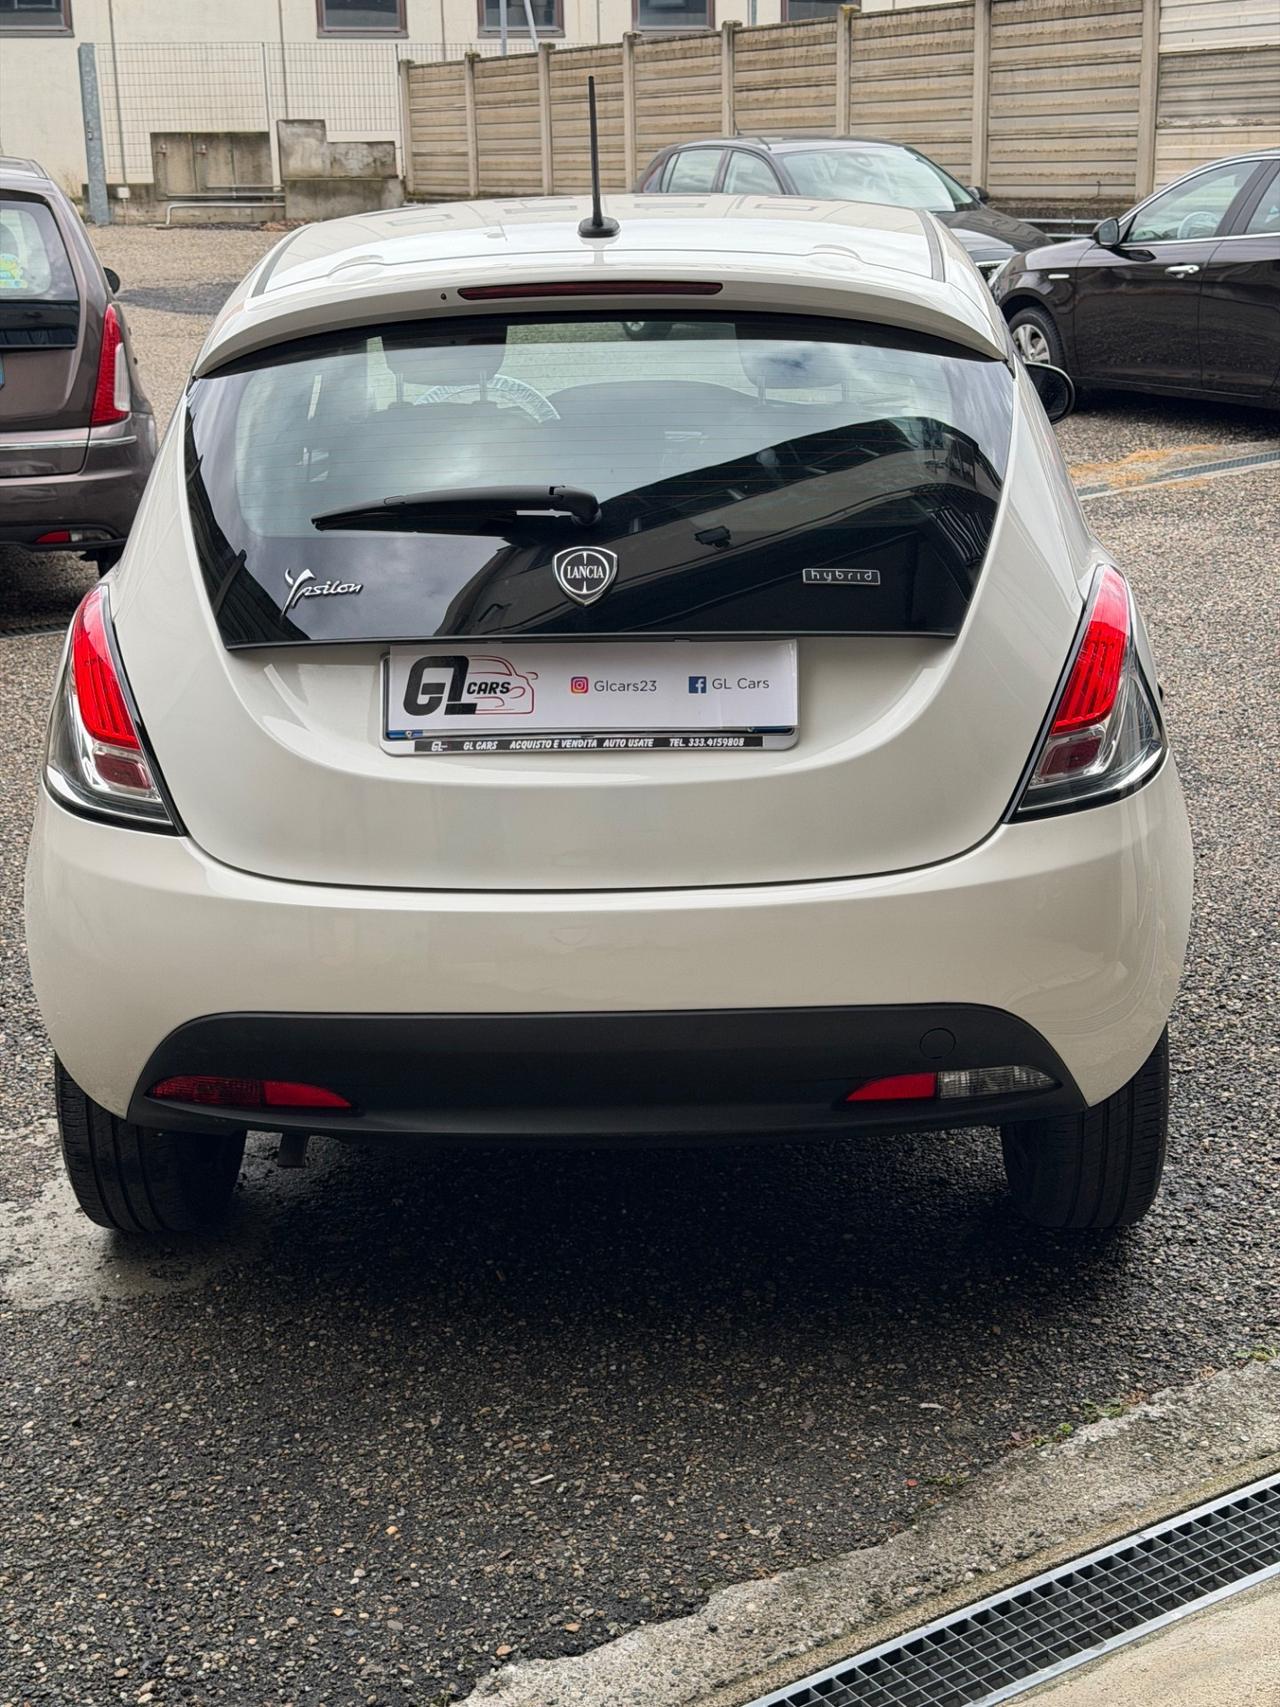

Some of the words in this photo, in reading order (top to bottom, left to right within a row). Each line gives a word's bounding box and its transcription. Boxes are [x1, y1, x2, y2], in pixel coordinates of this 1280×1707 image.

[567, 565, 604, 579] LANCIA
[811, 569, 872, 583] hybrid
[281, 568, 362, 616] Ypsilon
[467, 682, 511, 695] CARS
[593, 680, 658, 692] Glcars23
[712, 678, 732, 690] GL
[737, 677, 770, 689] Cars
[463, 741, 474, 750] GL
[475, 741, 498, 750] CARS
[510, 740, 551, 749] ACQUISTO
[553, 740, 560, 748] E
[561, 738, 598, 748] VENDITA
[603, 738, 626, 748] AUTO
[627, 738, 655, 747] USATE
[688, 737, 745, 747] 333.4159808
